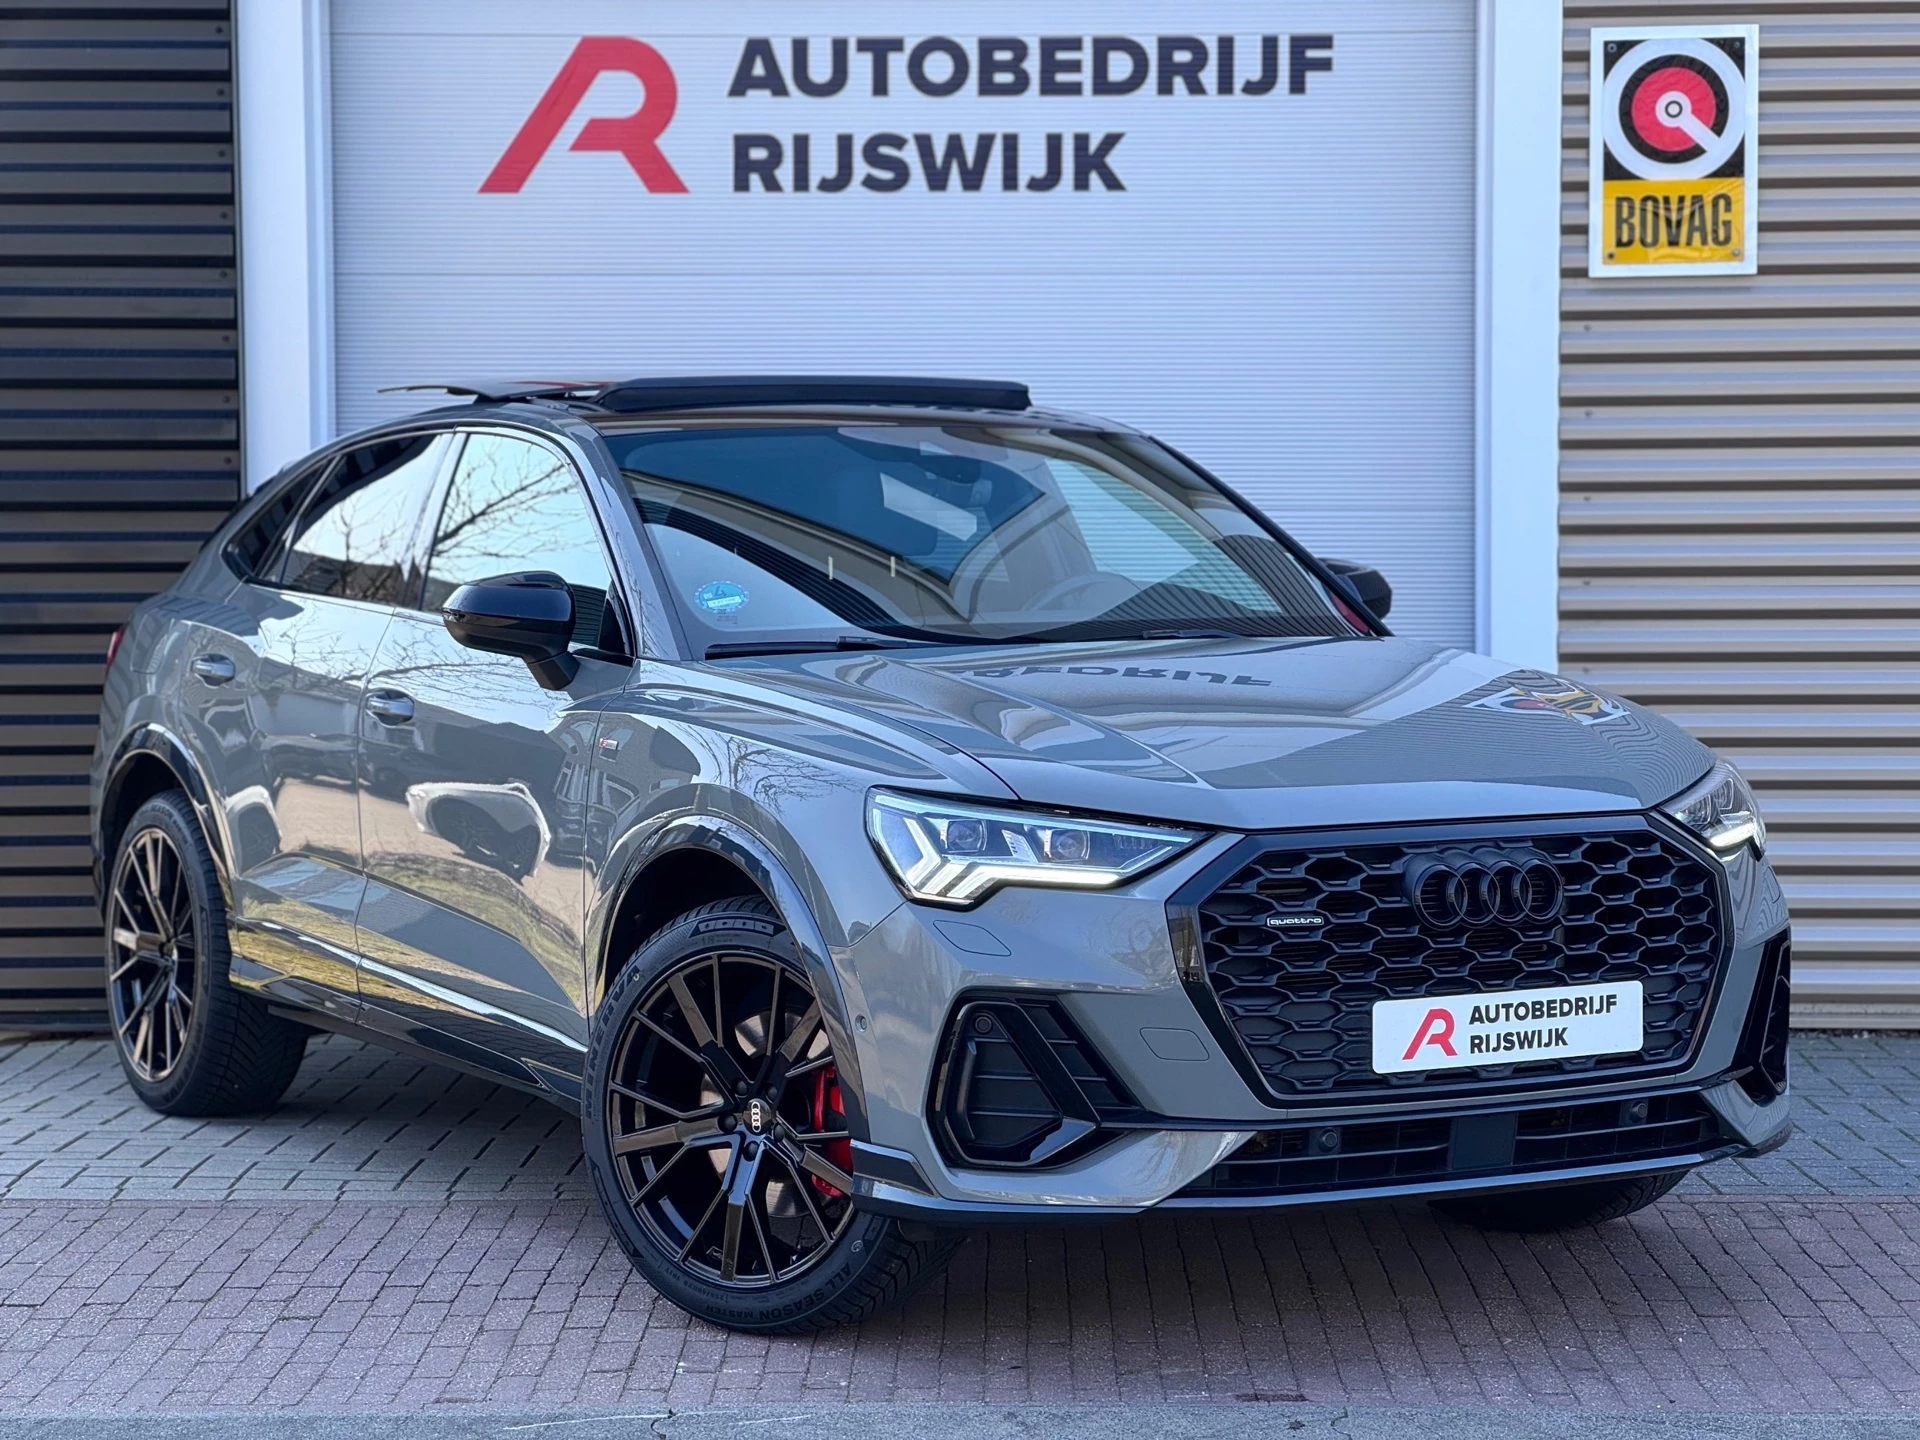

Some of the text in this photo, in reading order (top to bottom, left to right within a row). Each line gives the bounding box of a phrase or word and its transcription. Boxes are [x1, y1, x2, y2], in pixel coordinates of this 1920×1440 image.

[728, 34, 1334, 98] AUTOBEDRIJF
[732, 132, 1126, 193] RIJSWIJK
[1615, 193, 1732, 249] BOVAG
[1270, 917, 1322, 926] quattro
[1469, 994, 1618, 1025] AUTOBEDRIJF
[585, 965, 640, 1120] MINERVA
[1469, 1026, 1568, 1054] RIJSWIJK
[824, 1262, 852, 1291] ALL
[705, 1302, 754, 1320] MASTER
[758, 1288, 825, 1321] SEASON
